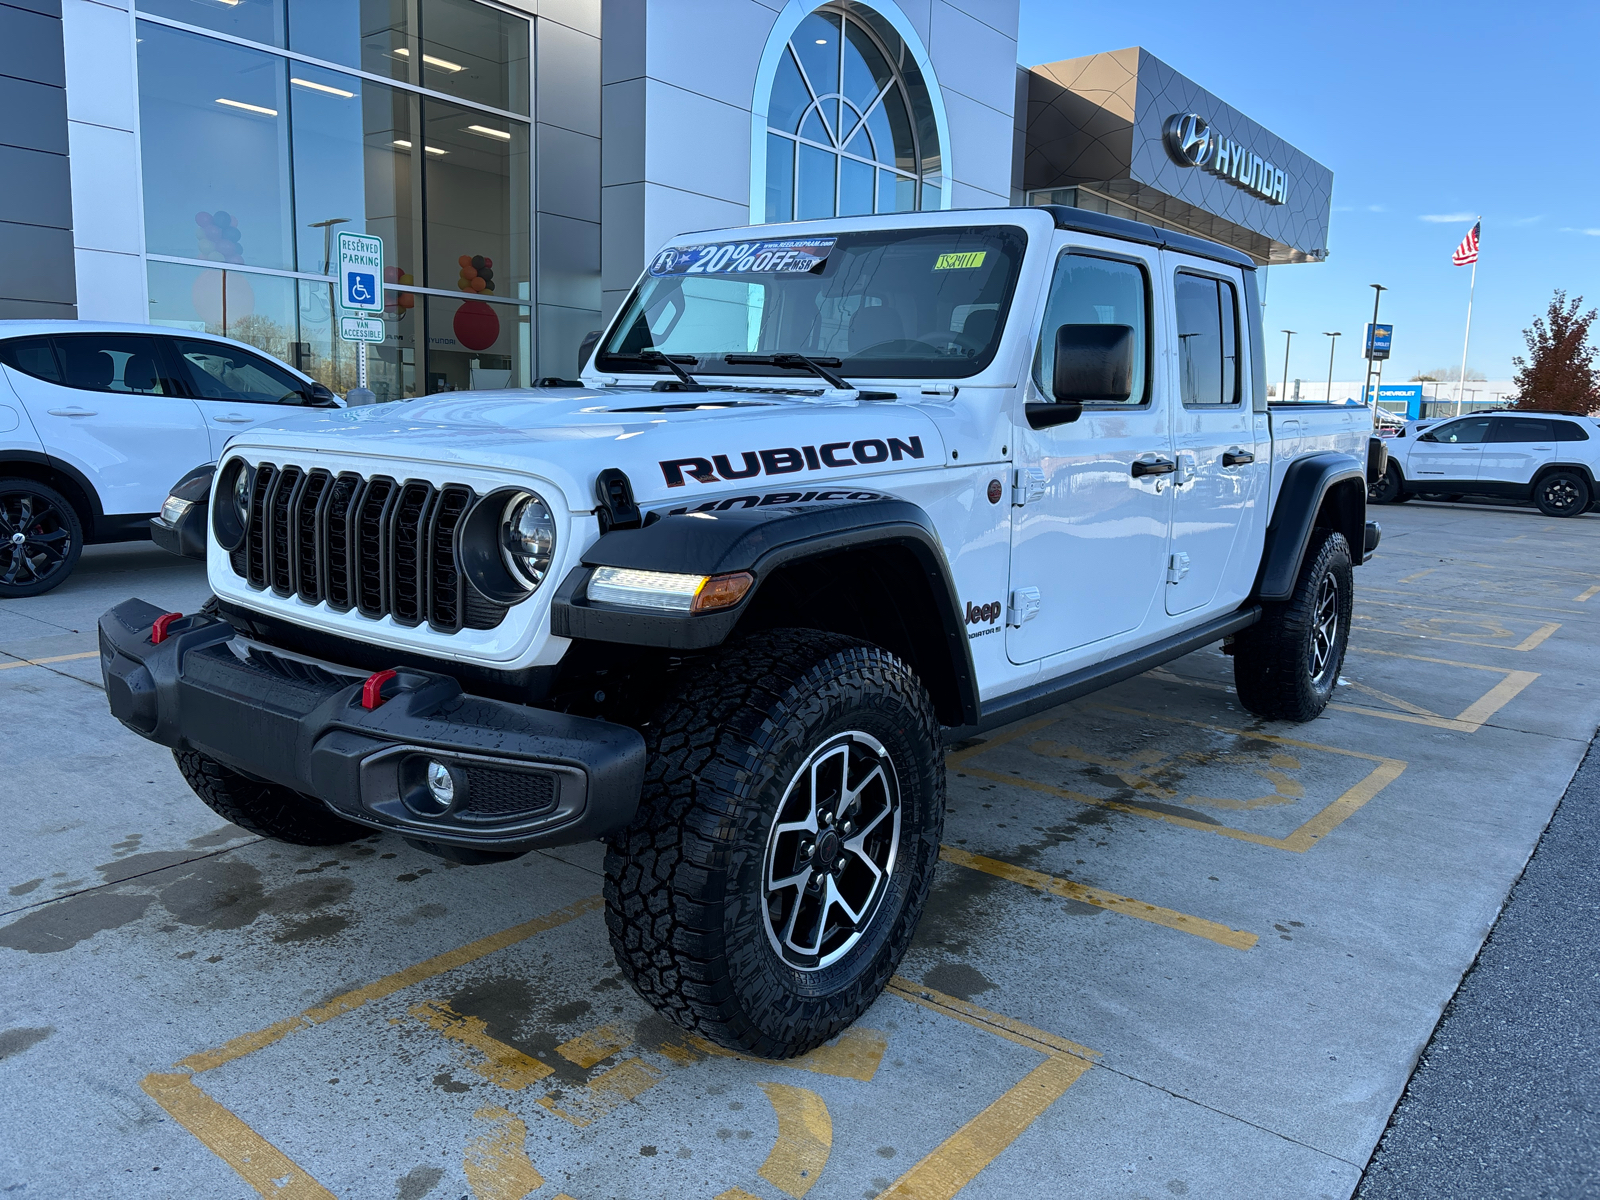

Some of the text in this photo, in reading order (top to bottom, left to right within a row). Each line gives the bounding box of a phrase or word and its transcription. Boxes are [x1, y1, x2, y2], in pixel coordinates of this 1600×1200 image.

[1214, 133, 1288, 204] HYUNDAI
[342, 239, 379, 254] RESERVED
[342, 253, 379, 267] PARKING
[686, 243, 813, 273] 20% OFF MSR
[343, 329, 381, 339] ACCESSIBLE
[356, 321, 369, 329] VAN
[659, 435, 925, 488] RUBICON
[965, 600, 1002, 625] Jeep
